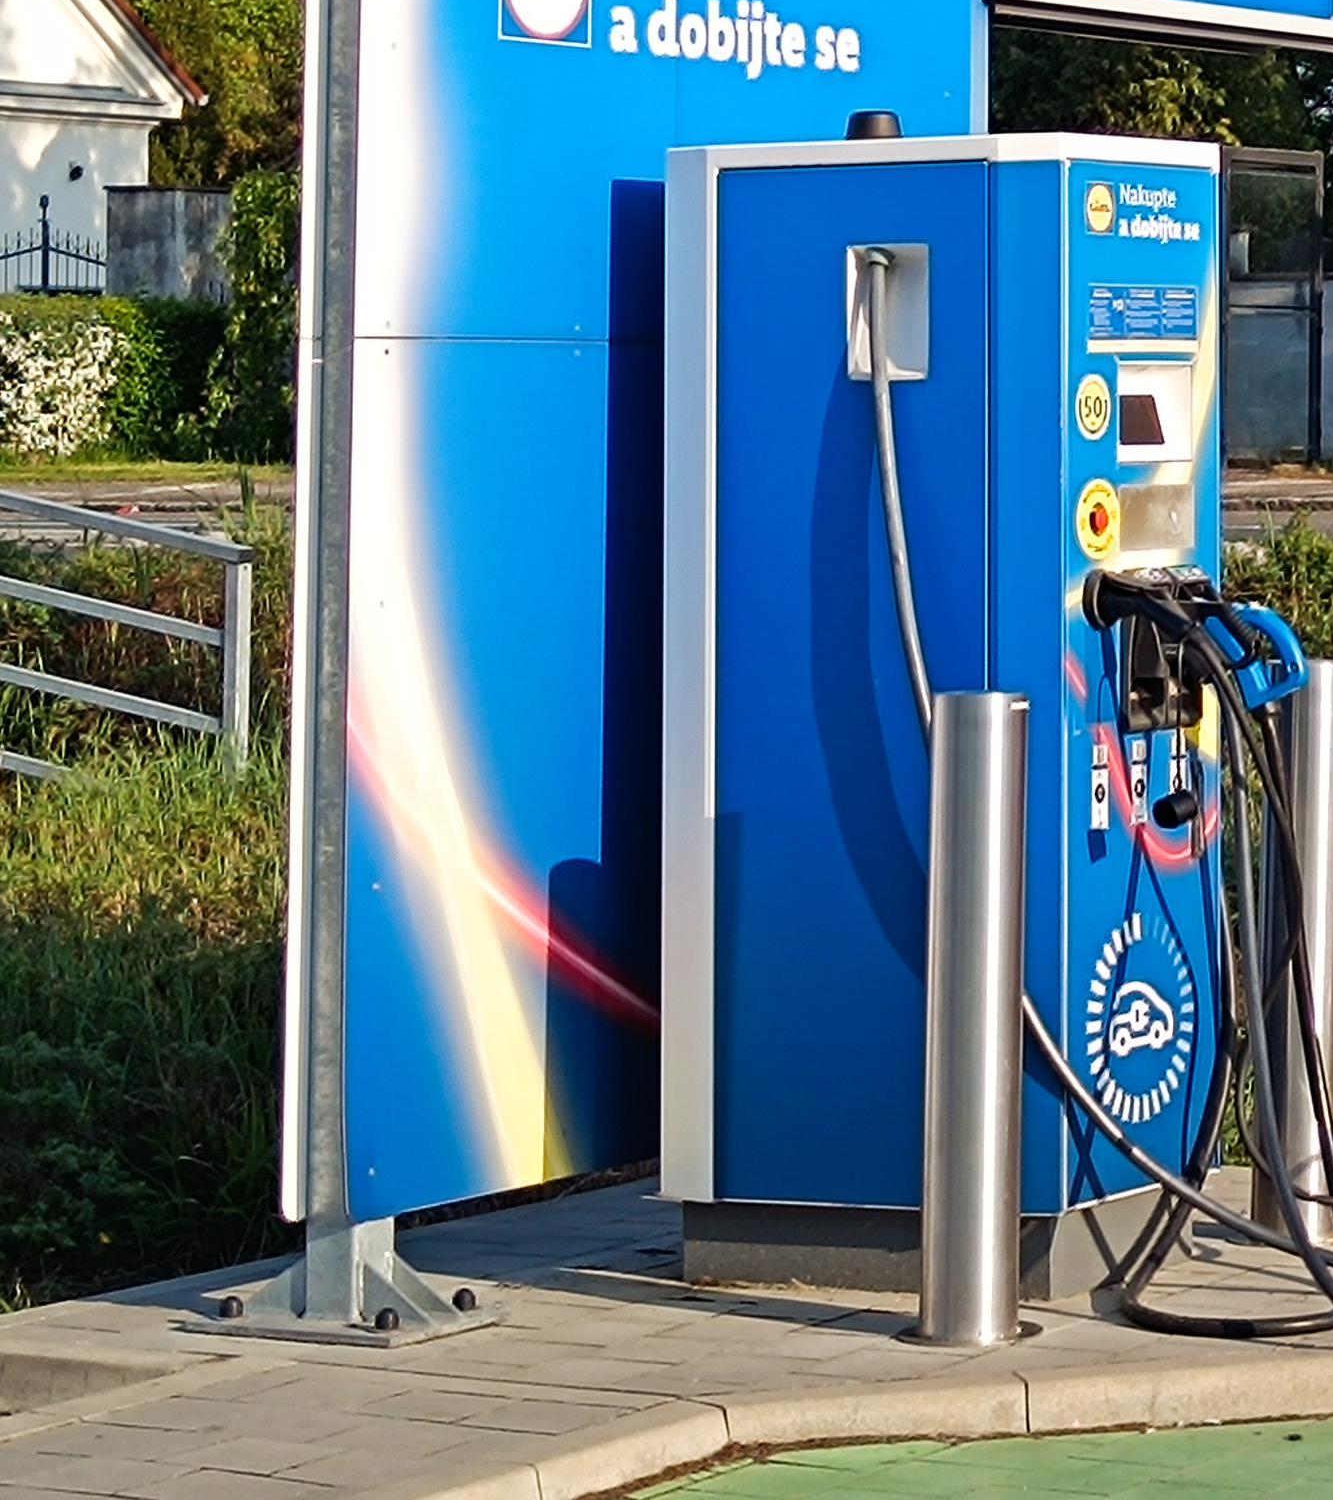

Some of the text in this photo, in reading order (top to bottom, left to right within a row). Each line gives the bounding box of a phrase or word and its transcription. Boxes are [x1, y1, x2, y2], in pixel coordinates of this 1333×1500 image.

[610, 4, 638, 54] a
[814, 25, 860, 74] se
[1119, 183, 1177, 212] Nakupte
[1118, 213, 1200, 244] a dobijte se
[1084, 396, 1102, 418] 50
